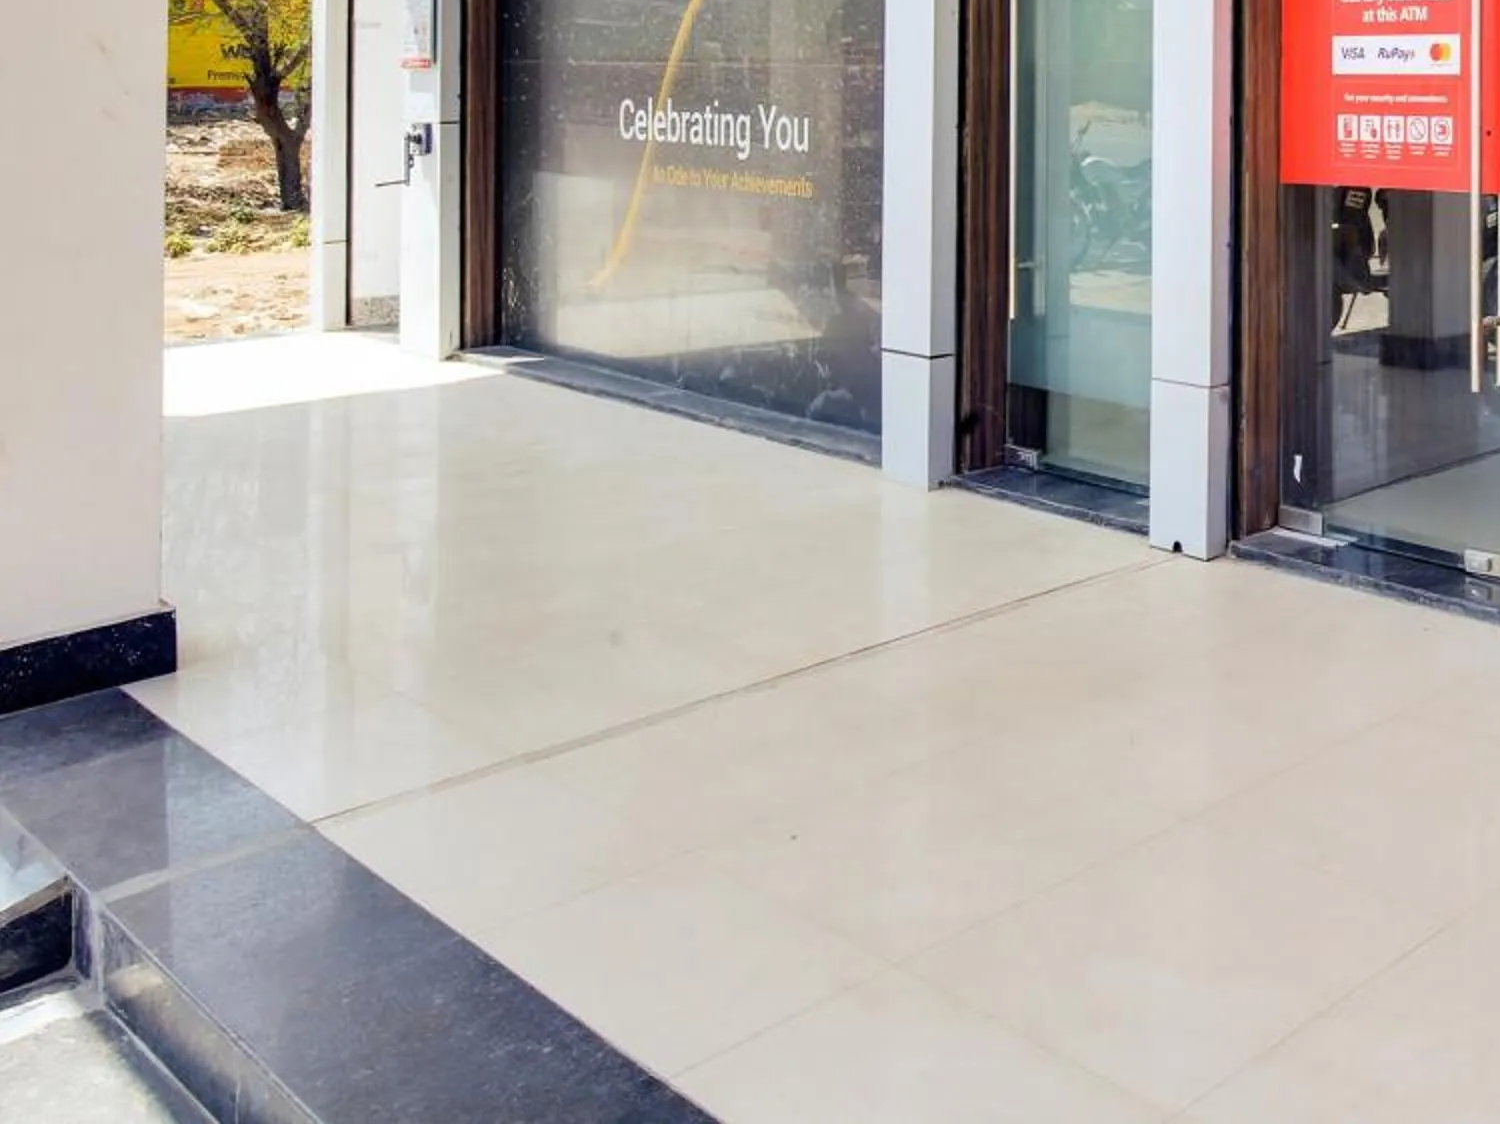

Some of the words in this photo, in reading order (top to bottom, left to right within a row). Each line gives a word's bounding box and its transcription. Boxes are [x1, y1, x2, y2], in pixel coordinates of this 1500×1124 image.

[1362, 8, 1374, 23] at
[1376, 5, 1397, 23] this
[1400, 5, 1429, 21] ATM
[1341, 46, 1366, 59] VISA
[1377, 46, 1410, 63] RuPay
[619, 97, 750, 160] Celebrating
[757, 104, 810, 153] You
[703, 167, 730, 190] Your
[731, 168, 814, 198] Achievements
